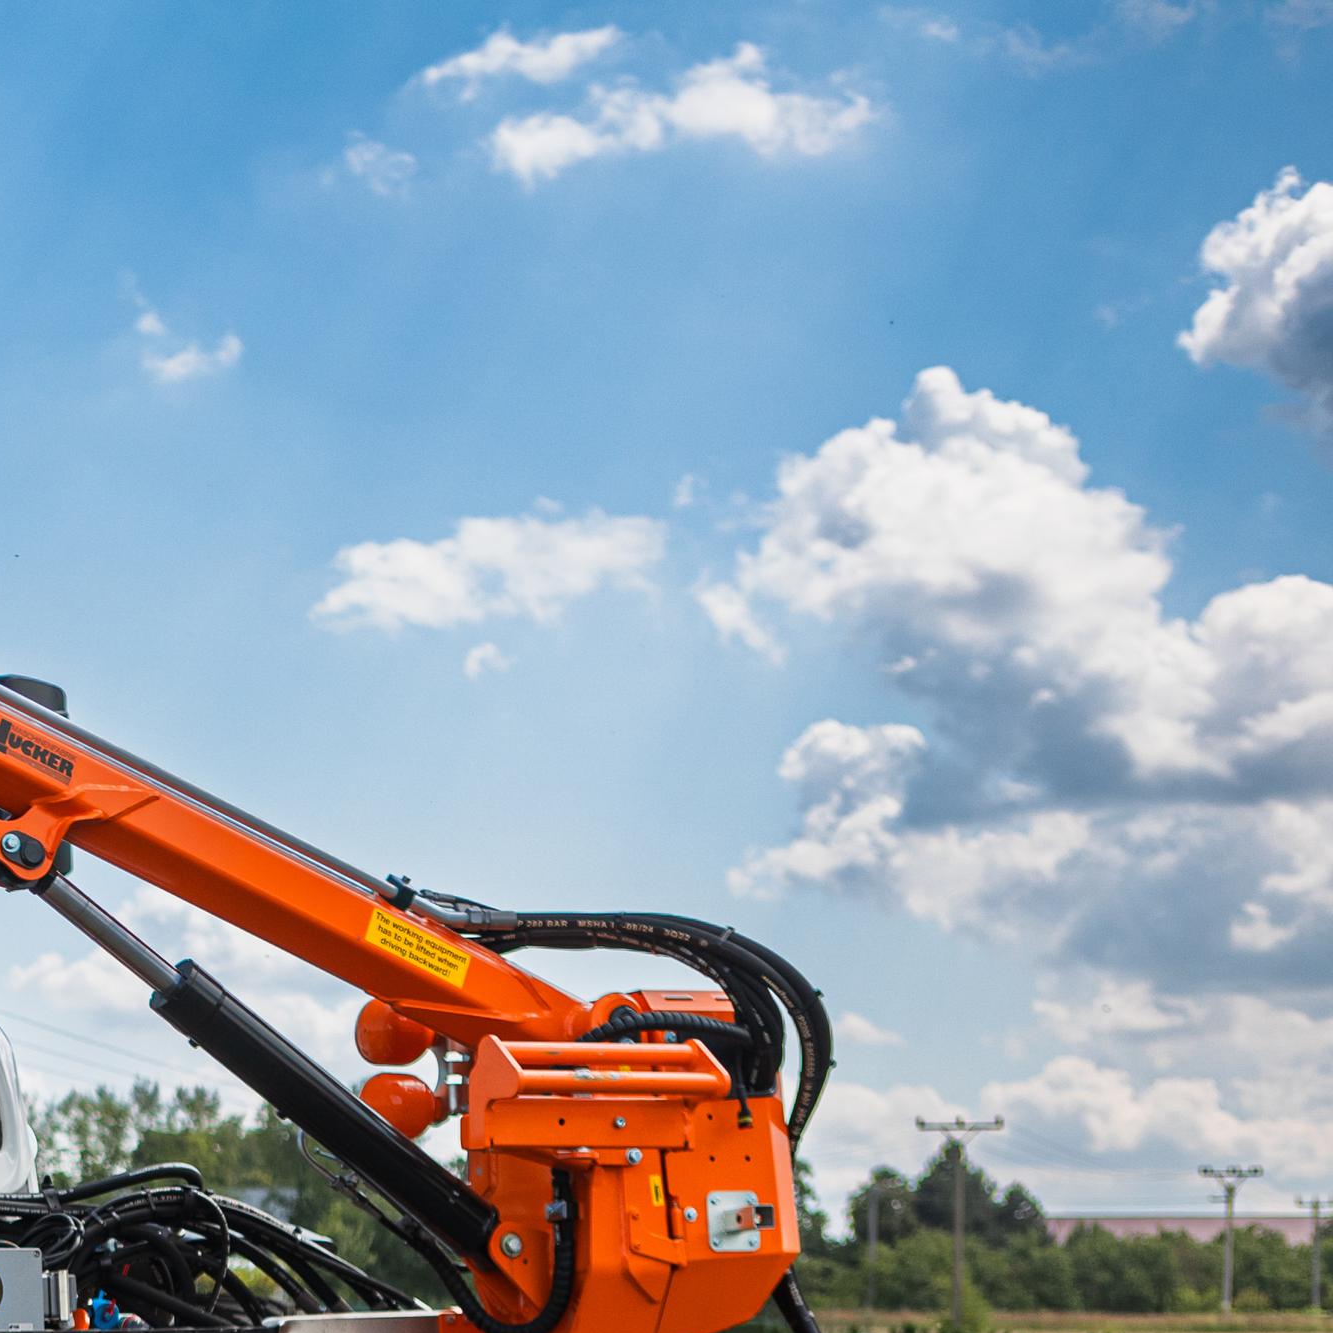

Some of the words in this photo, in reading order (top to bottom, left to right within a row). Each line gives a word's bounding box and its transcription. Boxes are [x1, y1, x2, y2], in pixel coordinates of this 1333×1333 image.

[376, 911, 391, 925] The
[392, 921, 424, 943] working
[425, 938, 468, 964] equipment
[377, 924, 392, 937] has
[394, 933, 402, 942] to
[404, 938, 414, 948] be
[415, 943, 436, 959] lifted
[437, 956, 459, 971] when
[380, 938, 407, 957] driving
